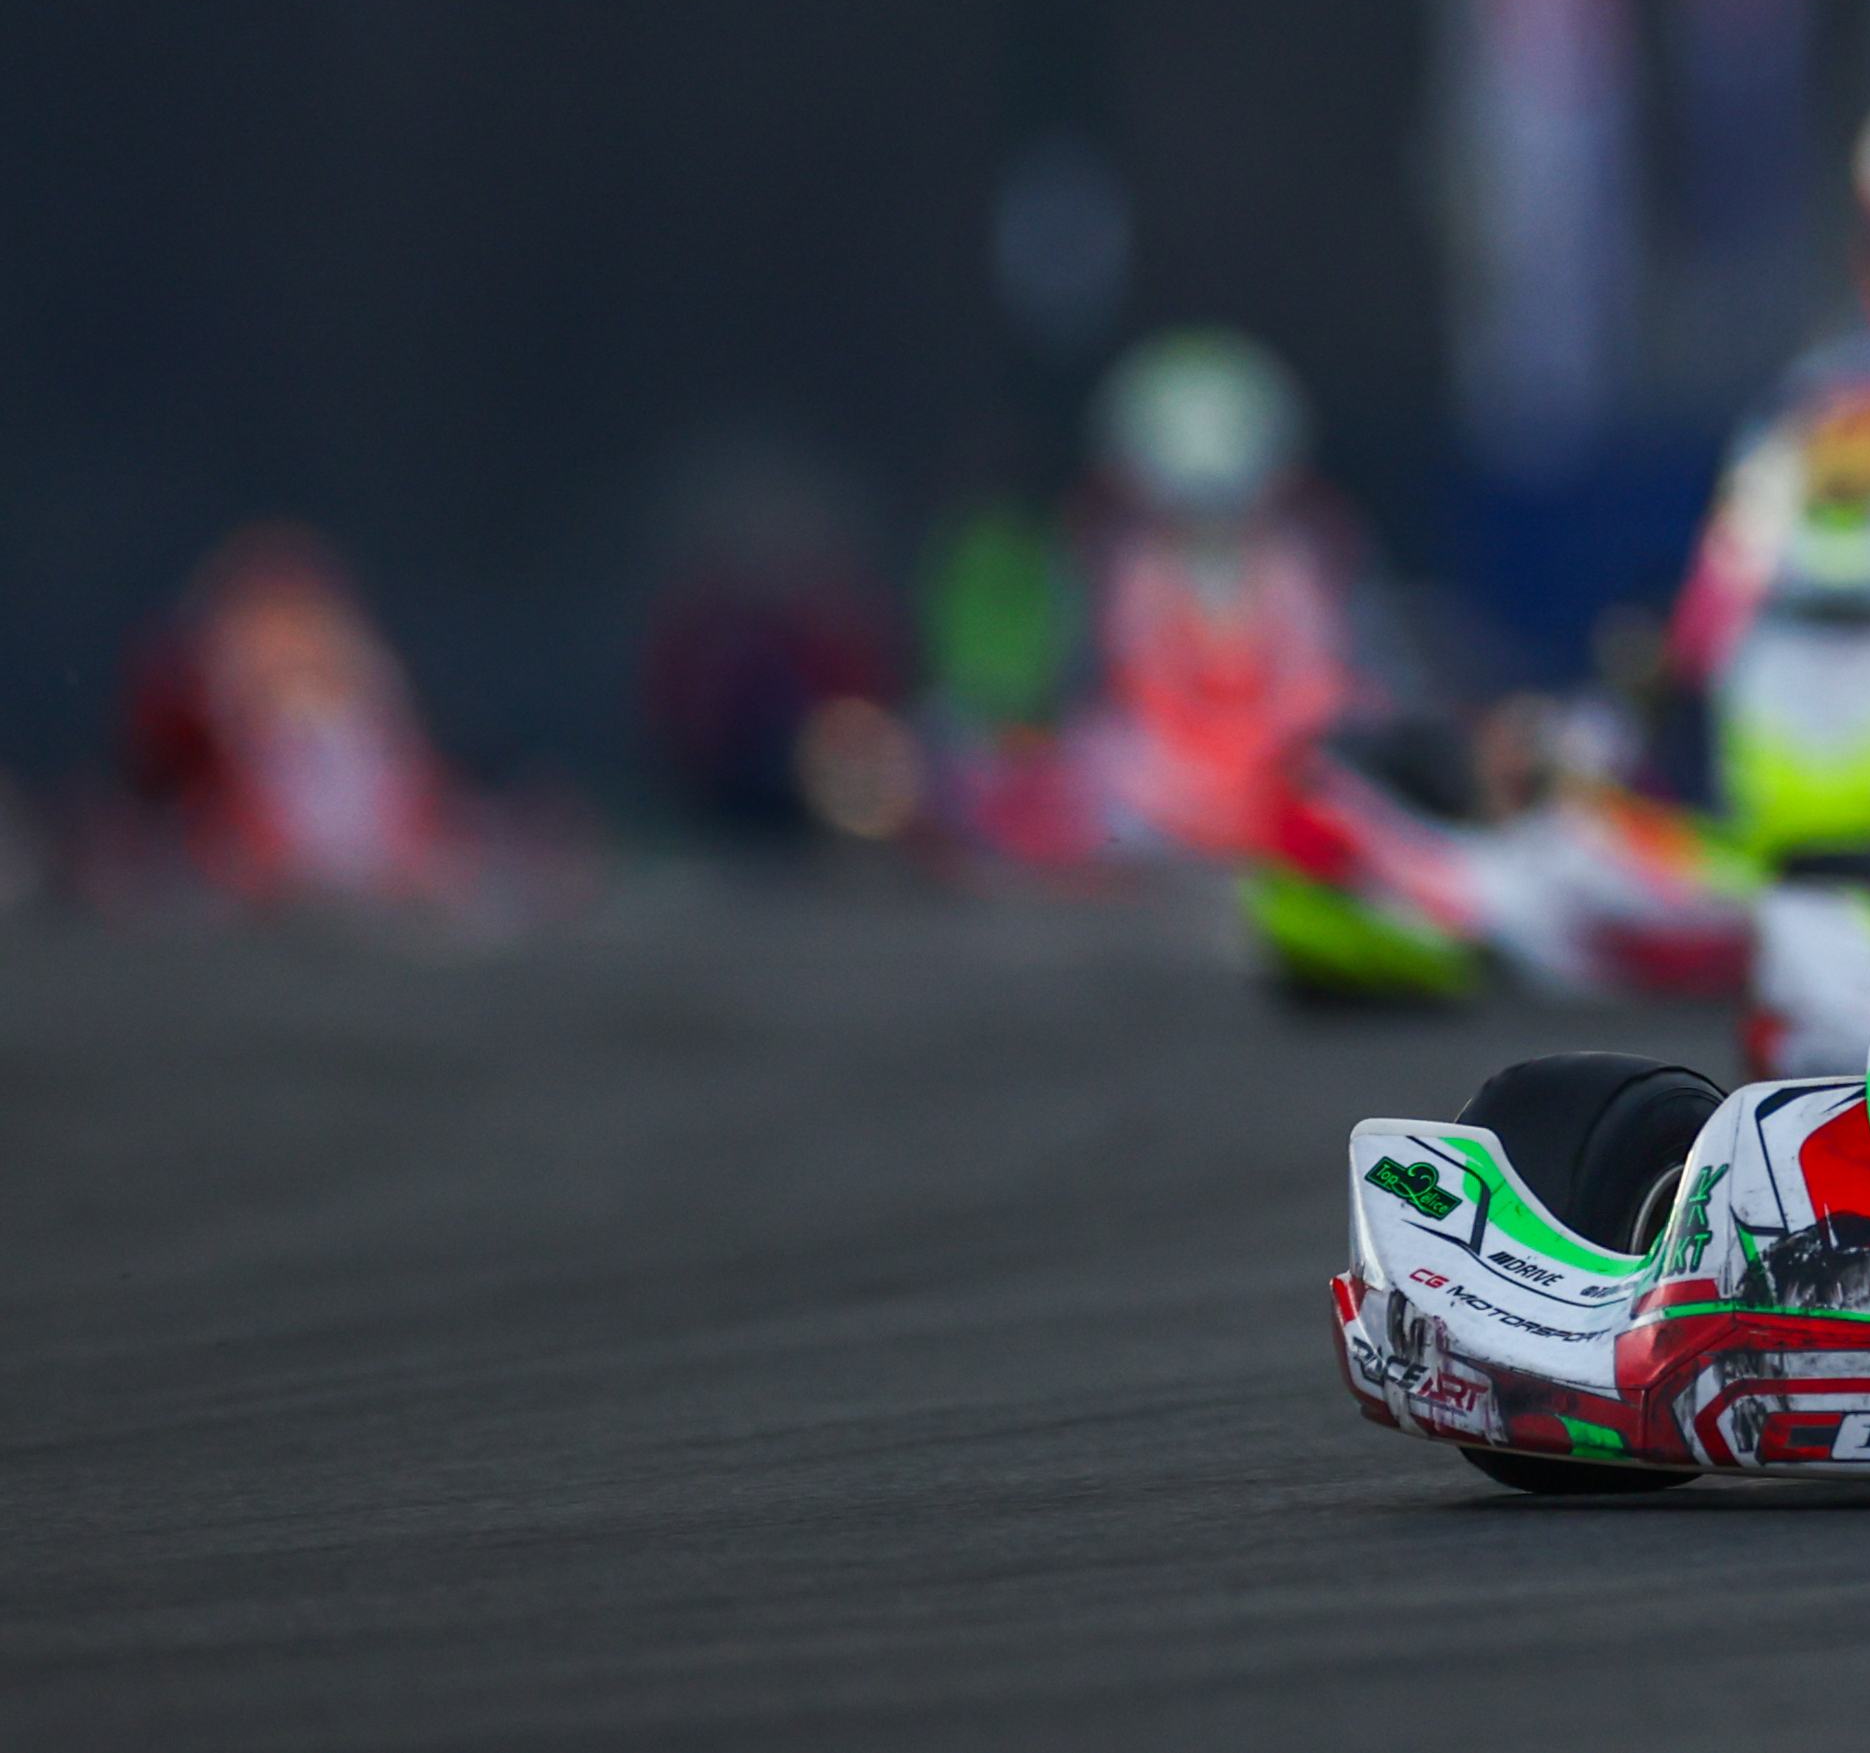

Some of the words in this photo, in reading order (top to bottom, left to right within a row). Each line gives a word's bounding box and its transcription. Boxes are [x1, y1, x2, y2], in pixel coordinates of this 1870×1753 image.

[1501, 1255, 1565, 1287] DRIVE
[1409, 1268, 1450, 1289] CG
[1446, 1285, 1613, 1342] MOTORSPORT
